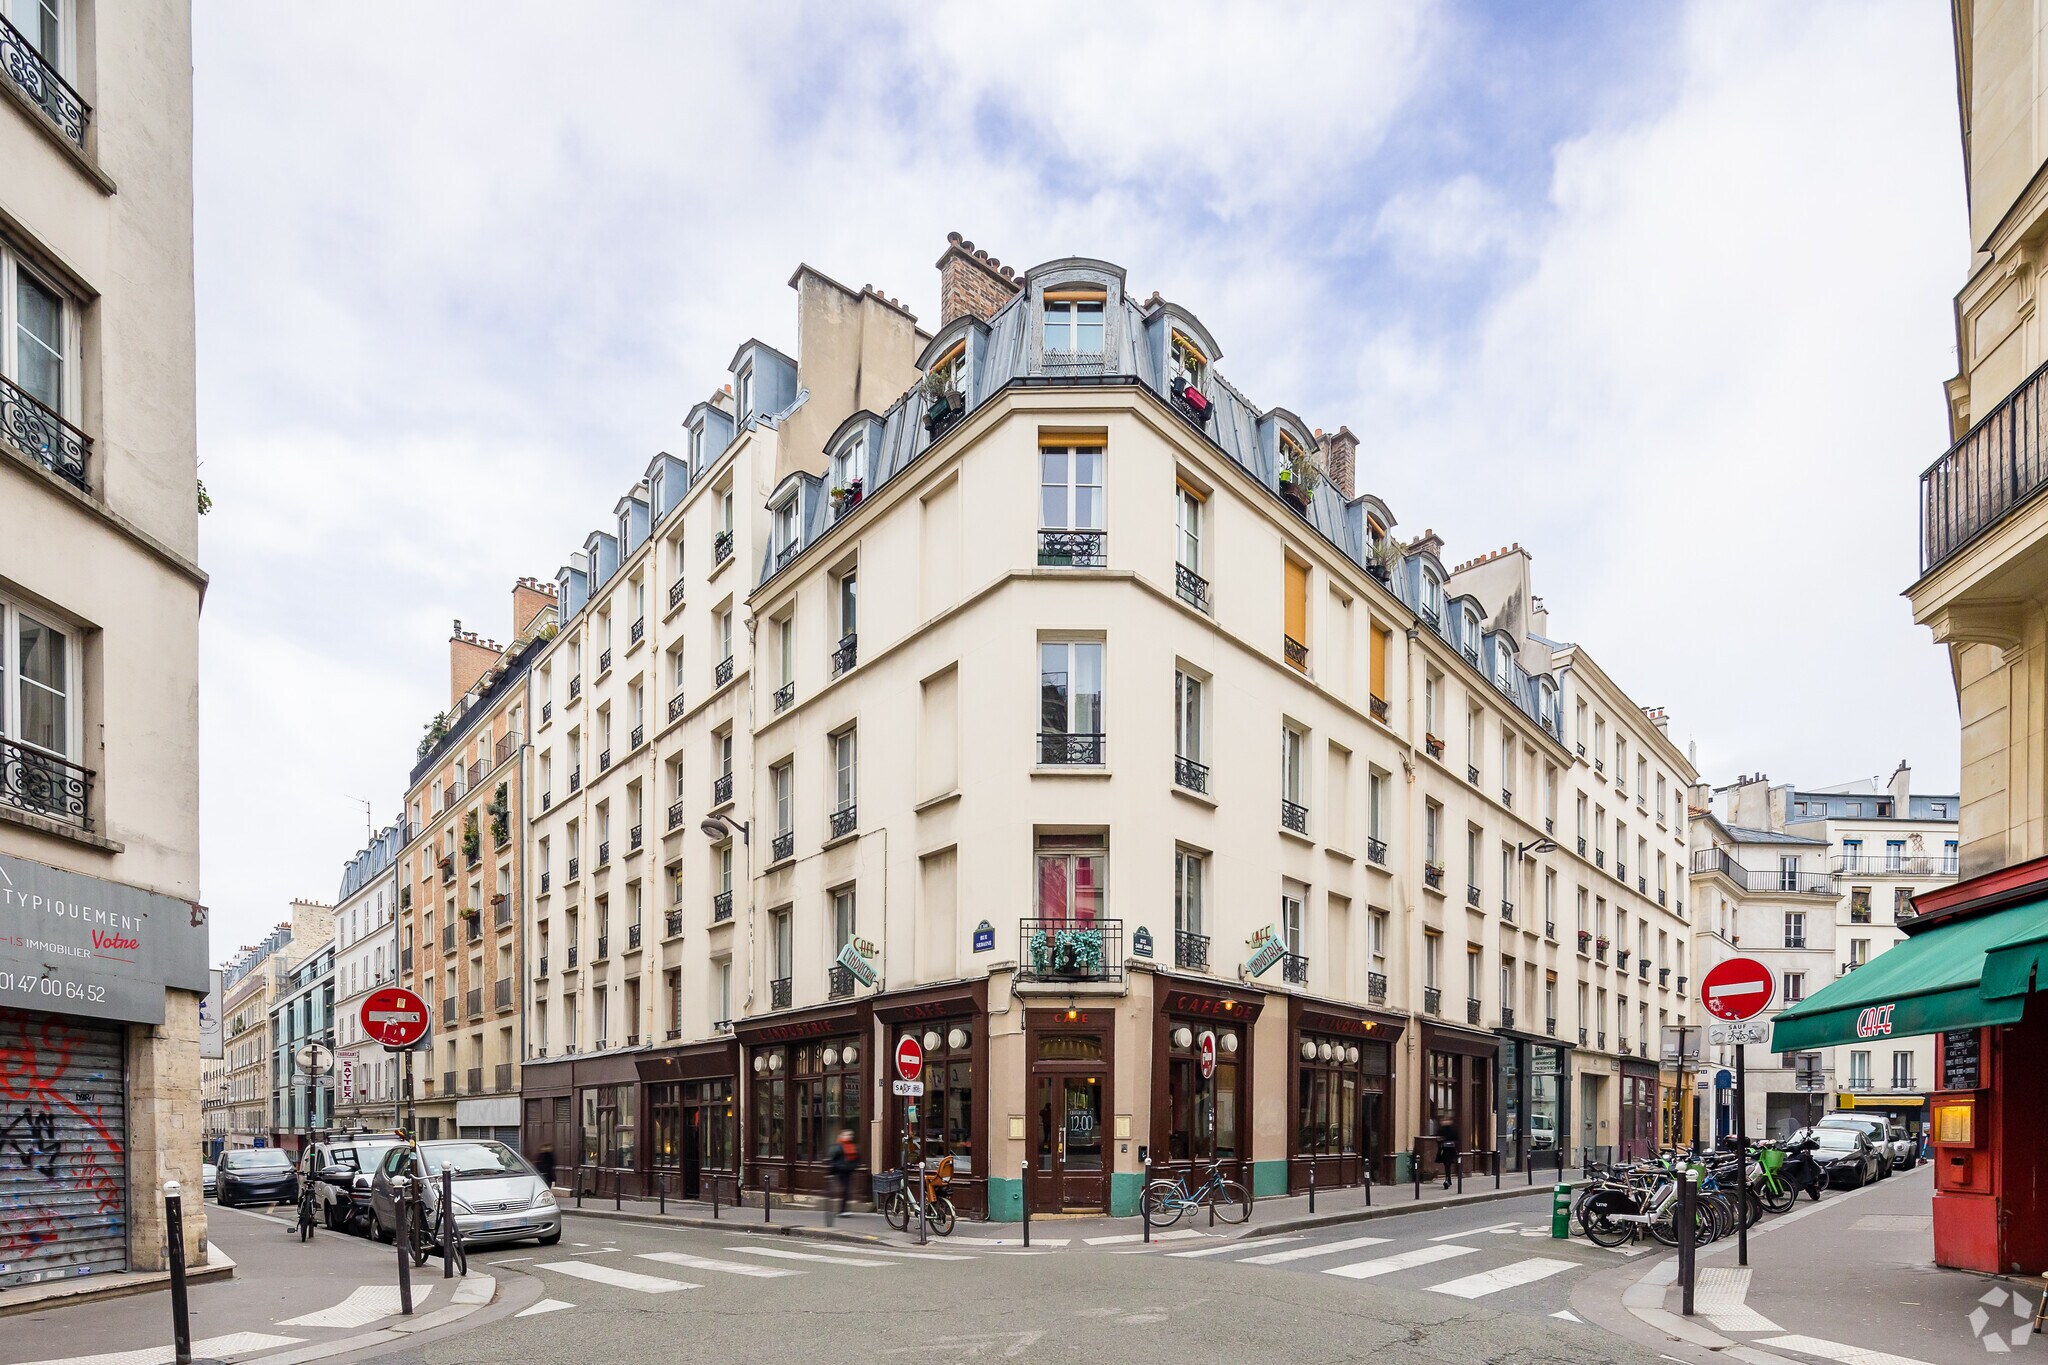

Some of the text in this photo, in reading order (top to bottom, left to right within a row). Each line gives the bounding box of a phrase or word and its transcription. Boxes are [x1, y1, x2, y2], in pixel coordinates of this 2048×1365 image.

[26, 938, 91, 959] IMMOBILIER
[91, 929, 140, 950] Votre
[0, 971, 105, 1003] 01 47 00 64 52
[1728, 1023, 1746, 1031] SAUF
[343, 1061, 352, 1098] SAYTEX
[1070, 1115, 1093, 1132] 12:00
